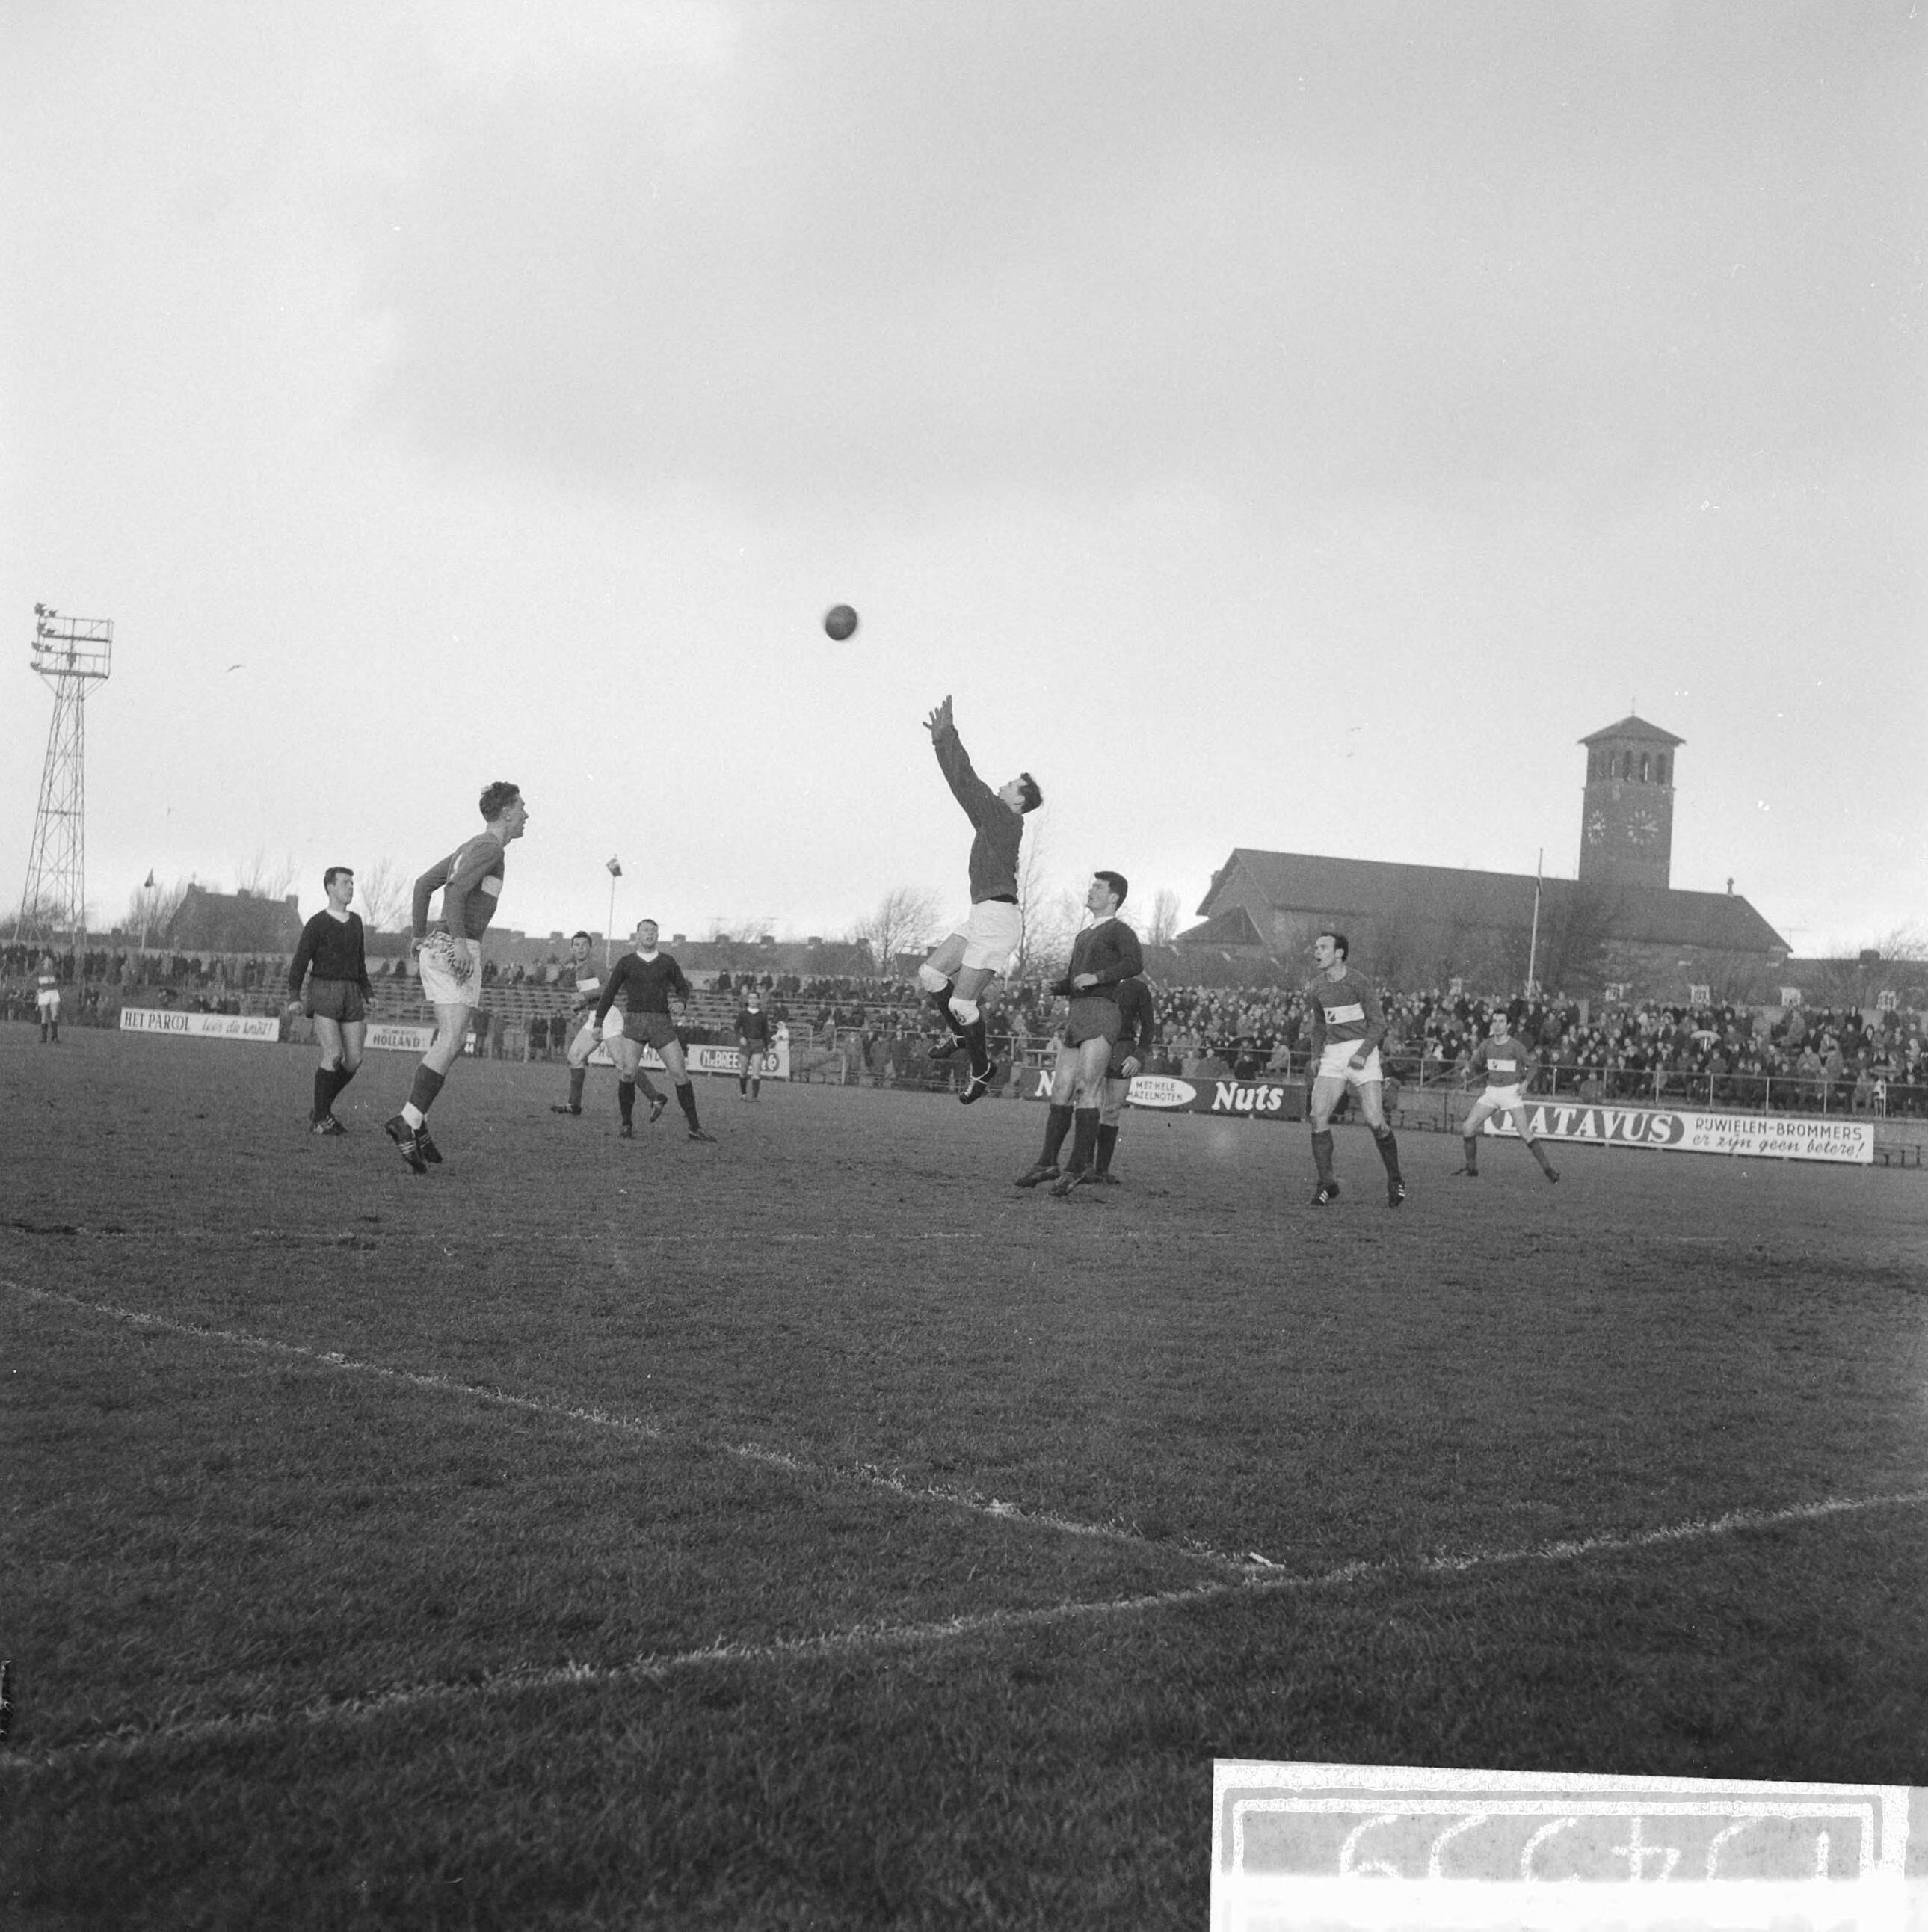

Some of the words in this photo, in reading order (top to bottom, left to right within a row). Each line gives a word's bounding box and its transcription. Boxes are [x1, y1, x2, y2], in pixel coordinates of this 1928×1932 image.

[124, 1011, 144, 1027] HET
[147, 1014, 190, 1031] PAROOL
[1136, 1080, 1153, 1090] MET
[1154, 1082, 1176, 1092] HELE
[1211, 1081, 1284, 1111] Nuts
[1692, 1133, 1710, 1146] er
[1716, 1133, 1752, 1152] zijn
[1758, 1139, 1801, 1153] geen
[1806, 1138, 1865, 1159] betere!
